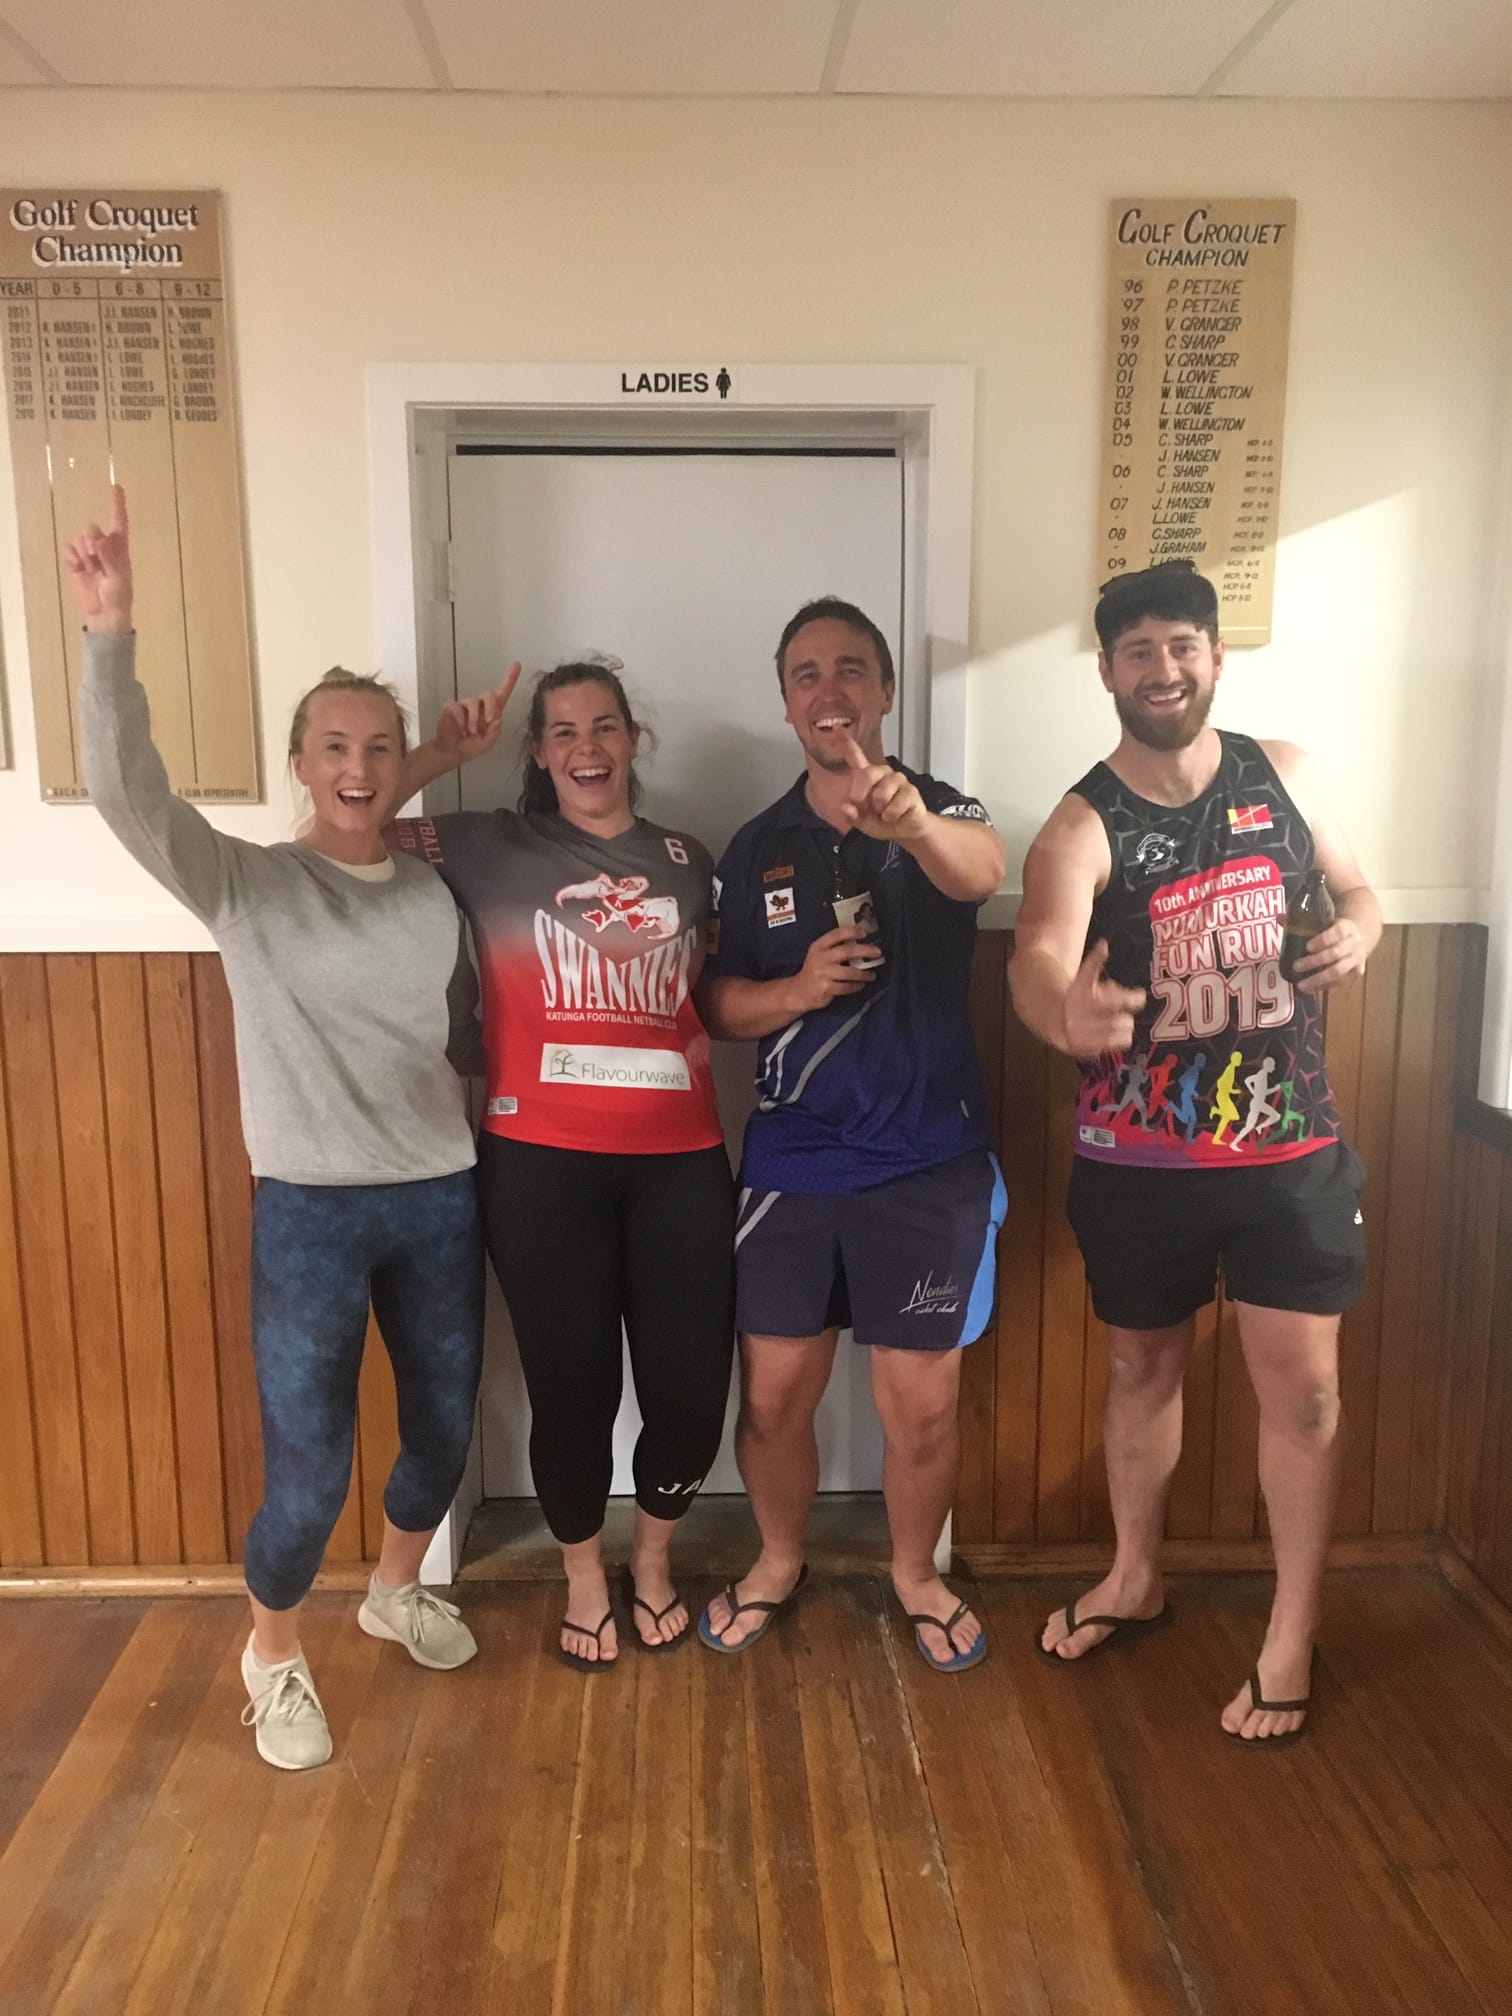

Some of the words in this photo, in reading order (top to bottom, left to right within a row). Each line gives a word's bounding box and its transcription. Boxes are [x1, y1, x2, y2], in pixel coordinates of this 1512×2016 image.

[12, 199, 78, 229] Golf
[87, 199, 199, 236] Croquet
[1118, 208, 1175, 244] GOLF
[1183, 208, 1286, 244] CROQUET
[34, 236, 184, 270] Champion
[1145, 249, 1250, 267] CHAMPION
[0, 282, 33, 295] YEAR
[1182, 279, 1243, 295] PETZKE
[1182, 298, 1241, 313] PETZKE
[1180, 335, 1226, 350] SHARP
[621, 372, 709, 393] LADIES
[1177, 370, 1220, 384] LOWE
[1175, 386, 1254, 400] WELLINGTON
[1176, 402, 1215, 415] LOWE
[1173, 418, 1245, 431] WELLINGTON
[1175, 433, 1214, 447] SHARP
[1173, 449, 1221, 462] HANSEN
[1173, 465, 1209, 478] SHARP
[1171, 482, 1215, 494] HANSEN
[1166, 498, 1212, 511] HANSEN
[664, 837, 689, 866] 6
[1152, 932, 1216, 980] FUN
[1219, 921, 1284, 967] RUN
[534, 908, 697, 1018] SWANNIES
[1150, 960, 1294, 1041] 2019
[546, 1011, 585, 1022] KATUNGA
[586, 1011, 632, 1024] FOOTBALL
[581, 1062, 686, 1086] Flavourwave
